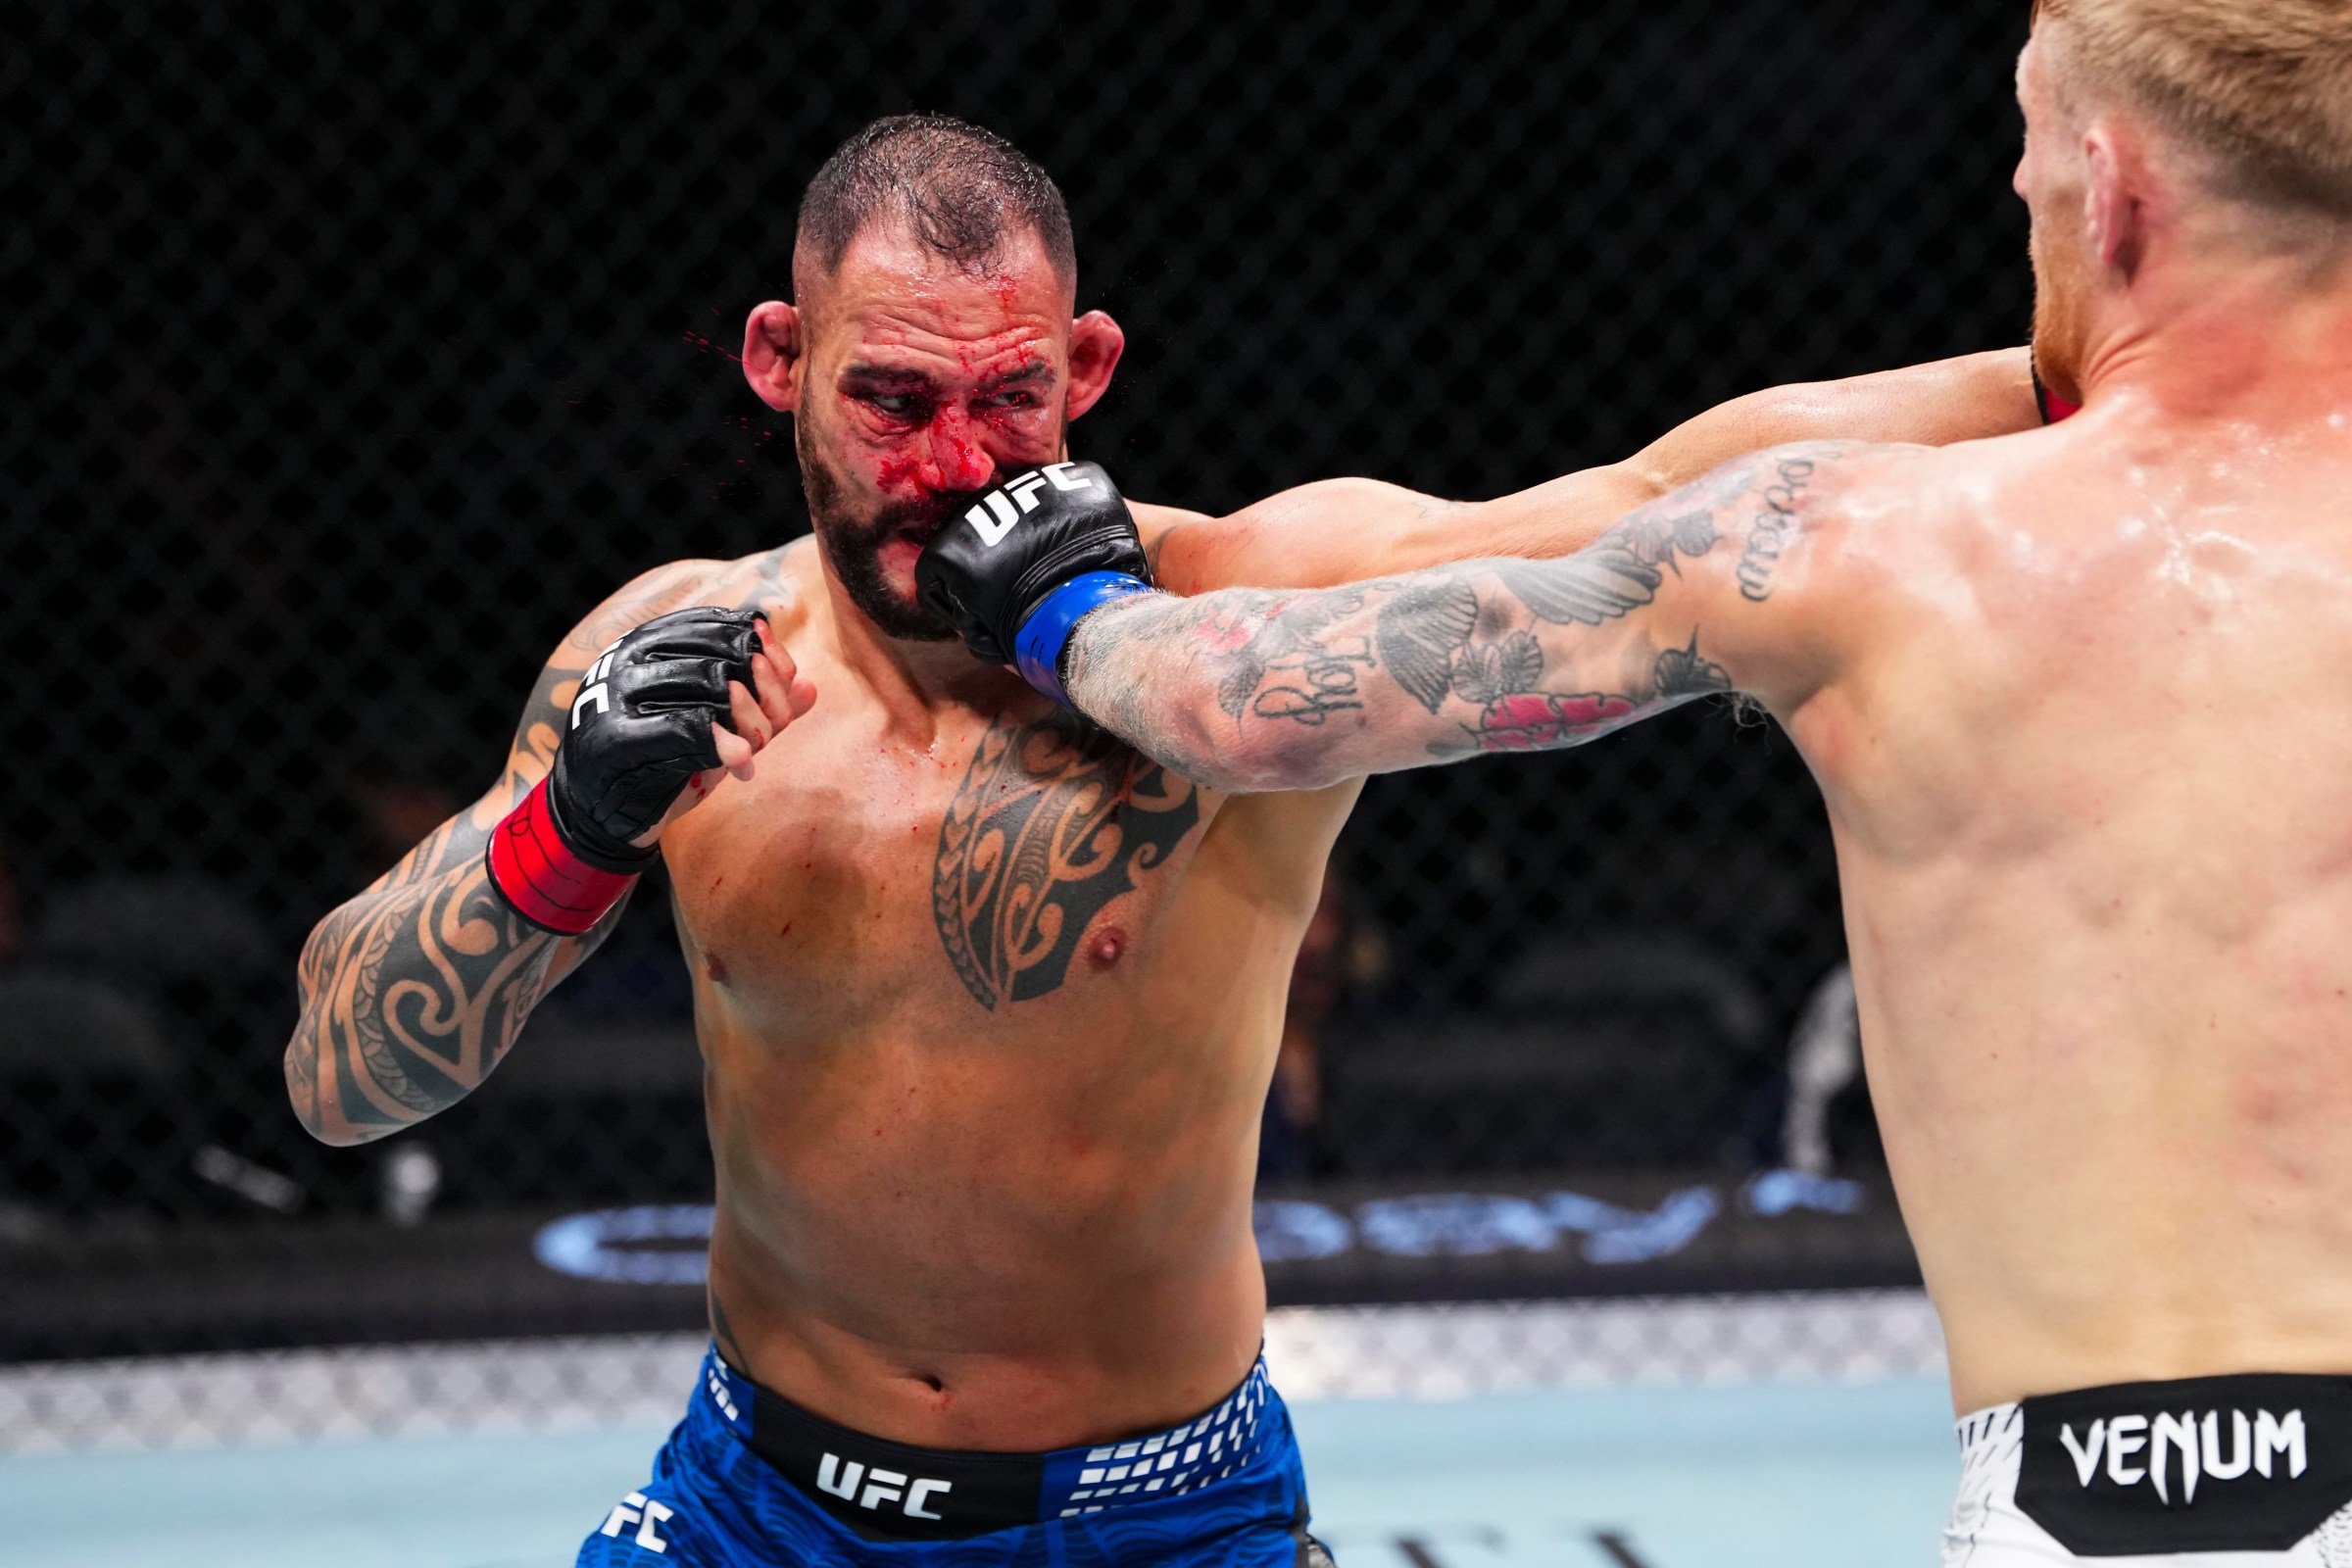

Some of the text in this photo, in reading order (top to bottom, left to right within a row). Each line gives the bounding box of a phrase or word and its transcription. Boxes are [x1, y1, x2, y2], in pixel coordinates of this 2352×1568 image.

[964, 461, 1093, 548] UFC
[816, 1452, 953, 1521] UFC
[2059, 1408, 2307, 1505] VENUM
[601, 1491, 675, 1554] FC
